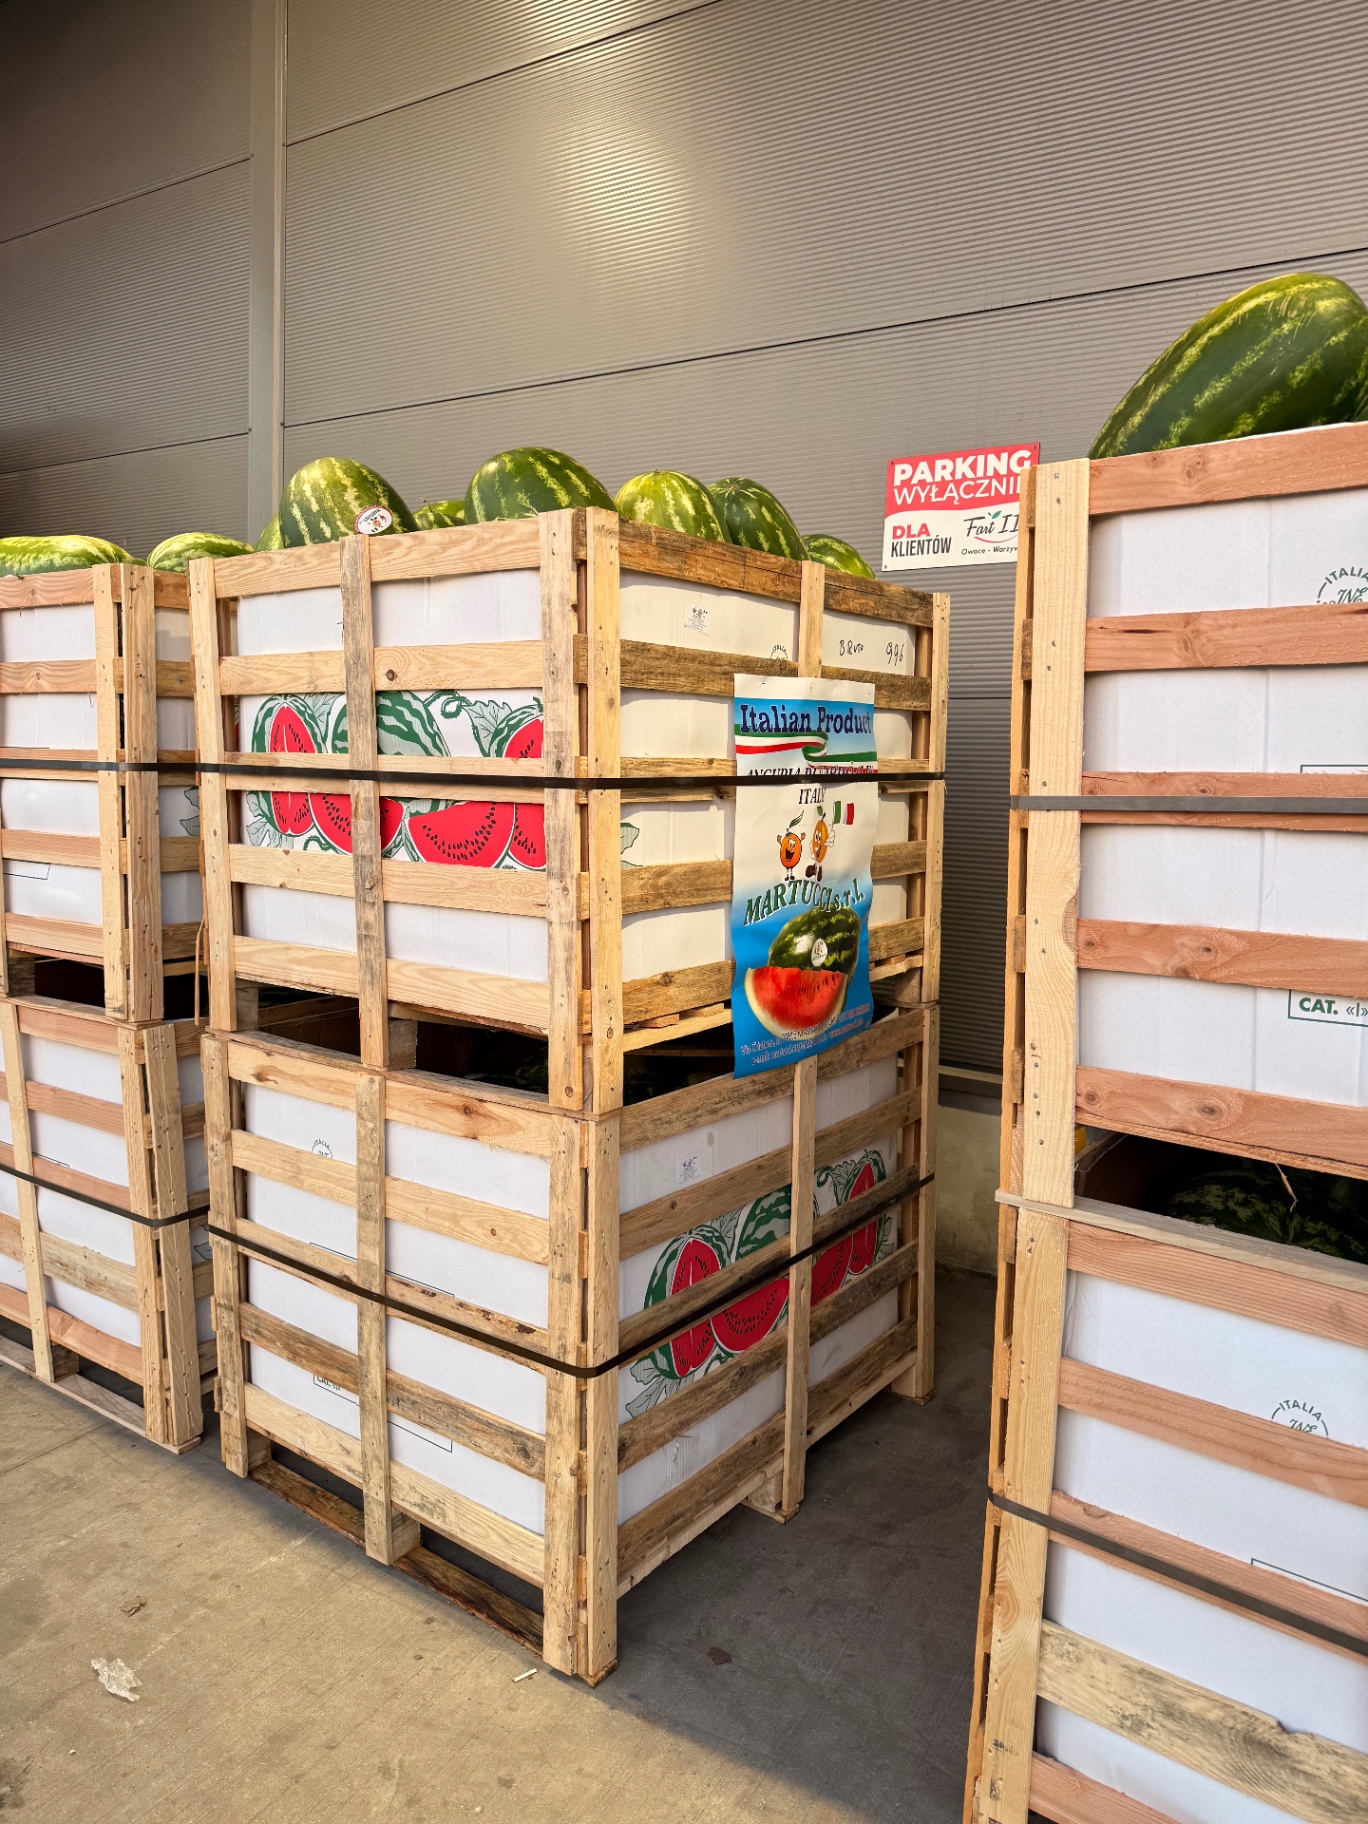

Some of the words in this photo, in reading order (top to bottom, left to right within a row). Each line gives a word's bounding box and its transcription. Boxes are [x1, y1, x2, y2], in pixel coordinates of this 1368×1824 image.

[893, 449, 1031, 486] PARKING
[892, 523, 930, 540] DLA
[891, 535, 952, 558] KLIENTÓW
[961, 548, 986, 556] Owoce
[740, 703, 812, 733] Italian
[817, 706, 872, 734] Product
[798, 787, 826, 805] ITALY
[743, 879, 833, 926] MARTUCCI
[1298, 997, 1338, 1015] CAT.
[1279, 1399, 1322, 1421] ITALIA
